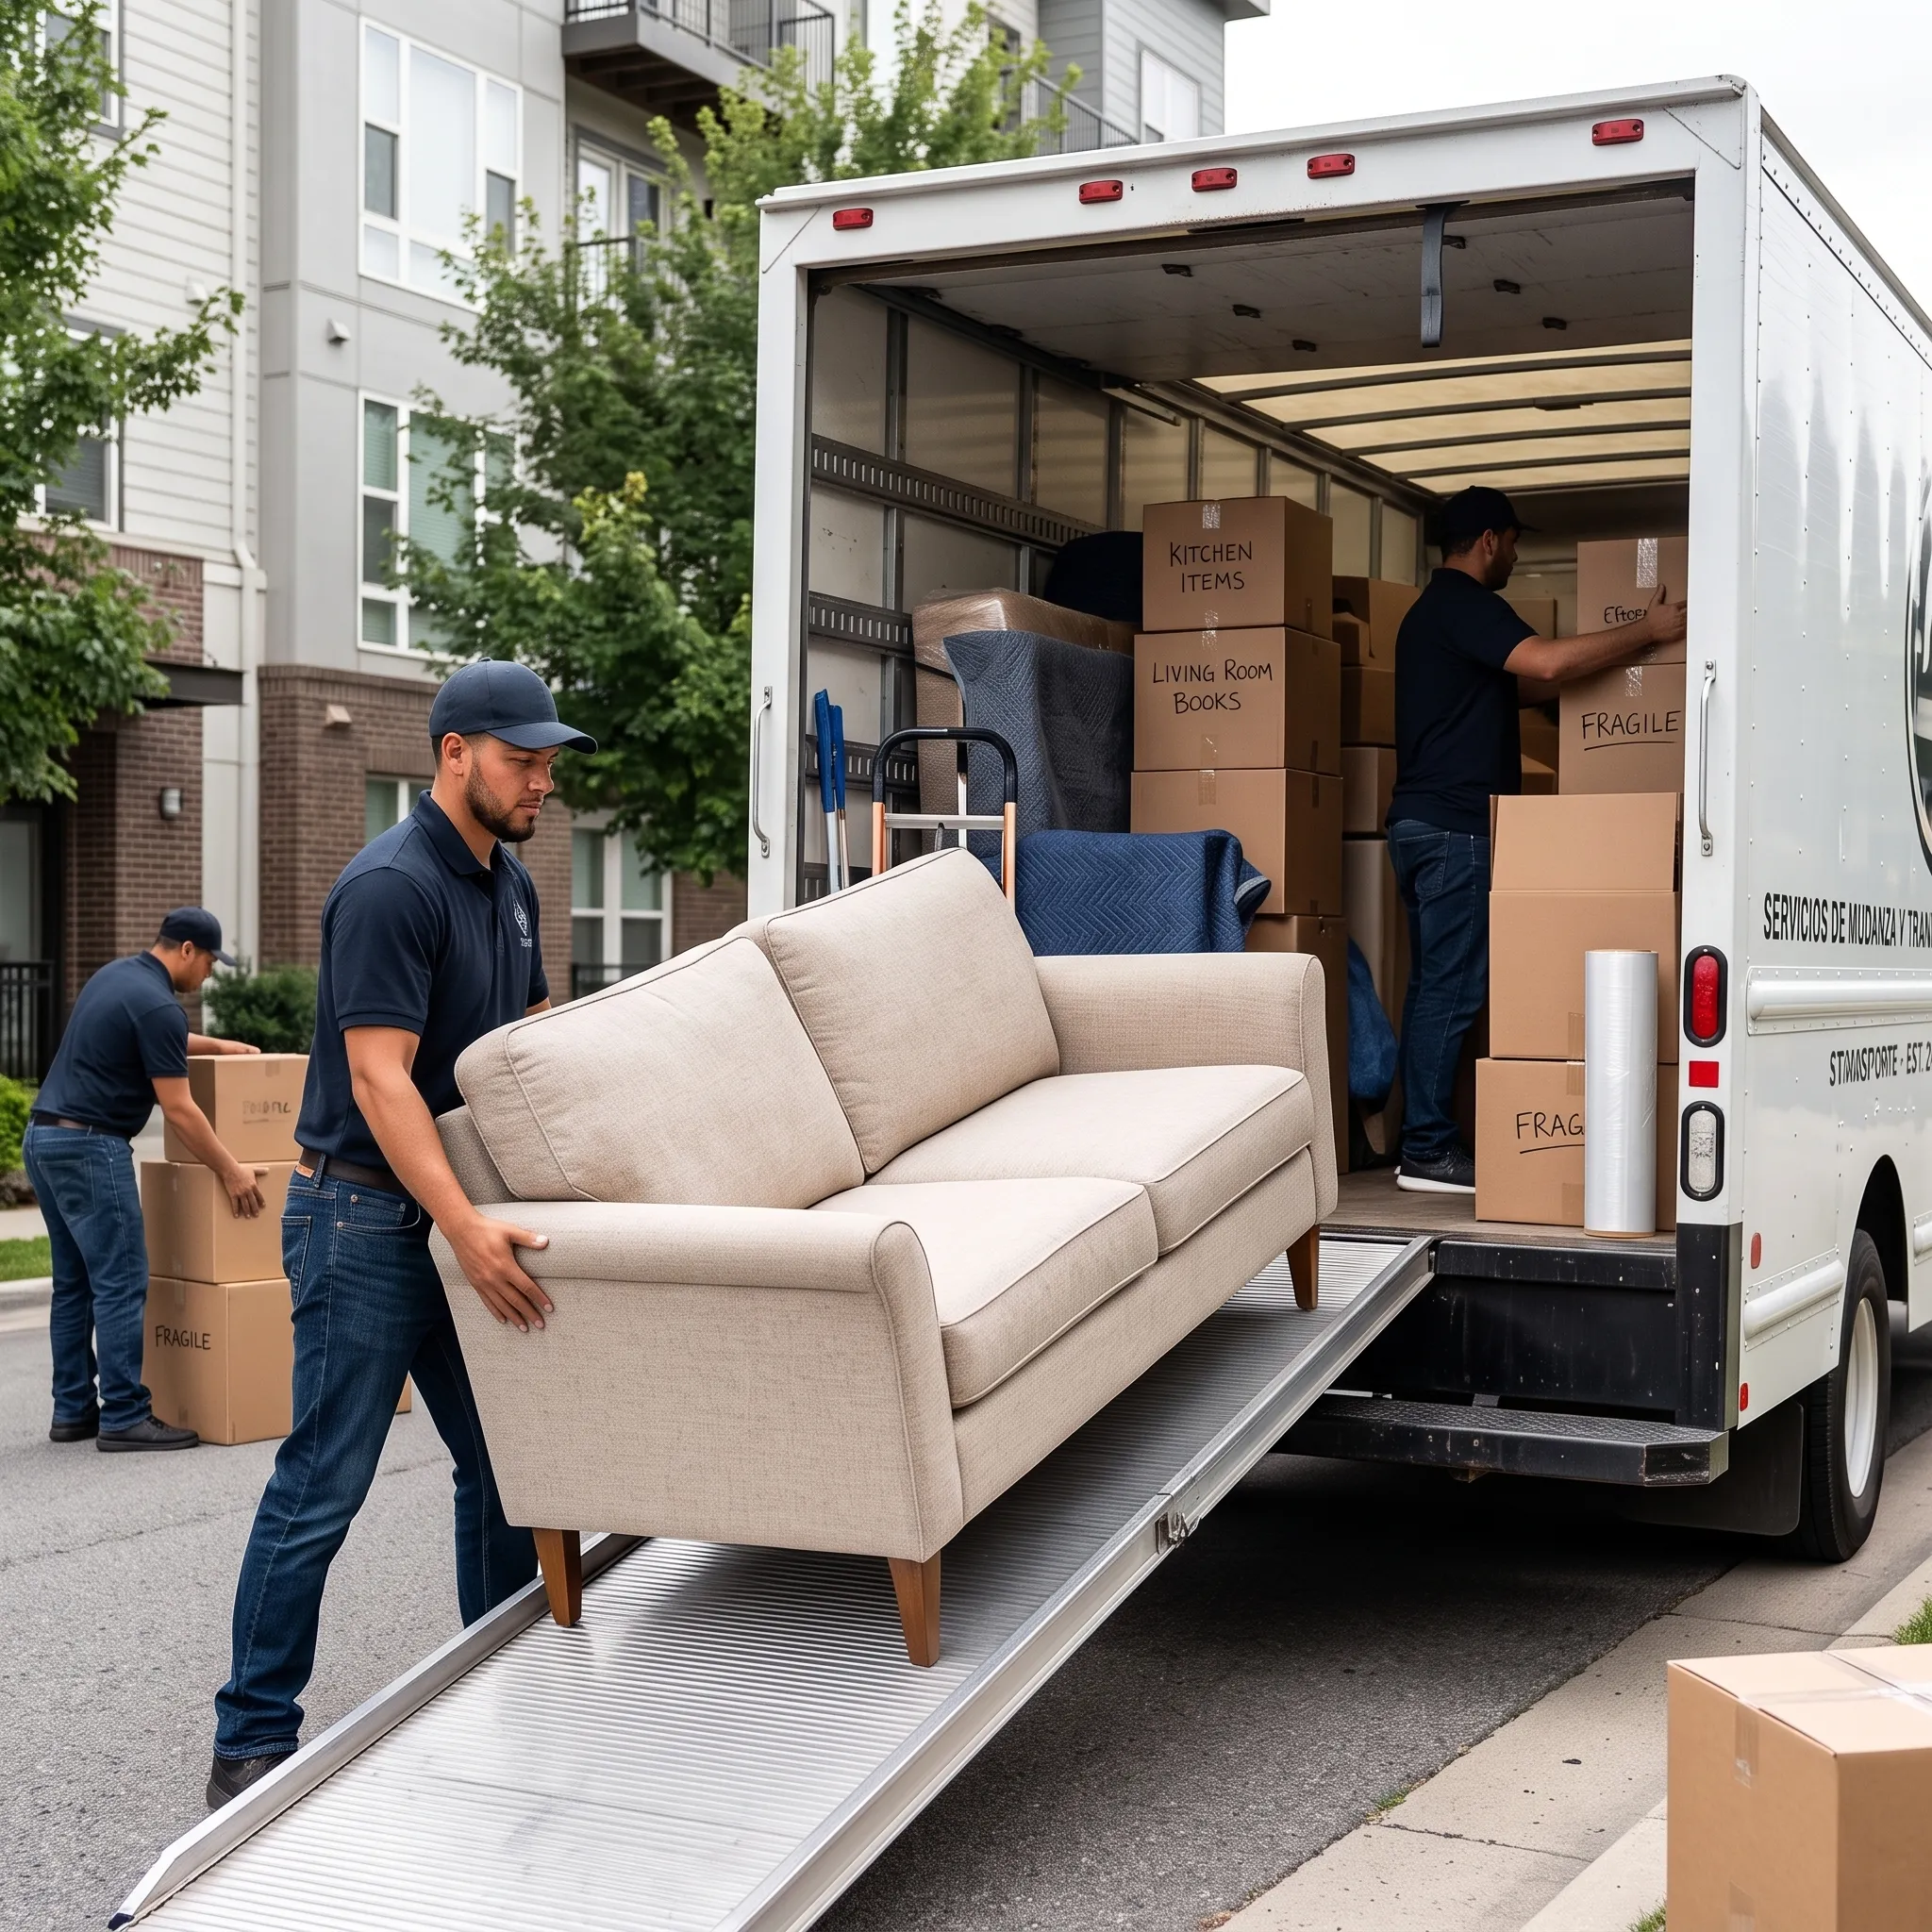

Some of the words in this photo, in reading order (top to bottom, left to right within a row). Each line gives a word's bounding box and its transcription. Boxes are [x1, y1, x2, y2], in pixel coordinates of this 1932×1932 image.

[1170, 541, 1252, 567] KITCHEN
[1181, 571, 1245, 592] ITEMS
[1153, 662, 1215, 683] LIVING
[1224, 658, 1273, 681] ROOM
[1173, 691, 1241, 714] BOOKS
[1581, 709, 1681, 740] FRAGILE
[1763, 891, 1828, 943] SERVICIOS
[1831, 900, 1846, 944] DE
[1848, 902, 1896, 947] MUDANZA
[1899, 908, 1906, 947] Y
[1906, 1041, 1924, 1074] EST.
[1925, 1041, 1932, 1072] 2
[1516, 1111, 1585, 1140] FRAG
[155, 1324, 211, 1351] FRAGILE
